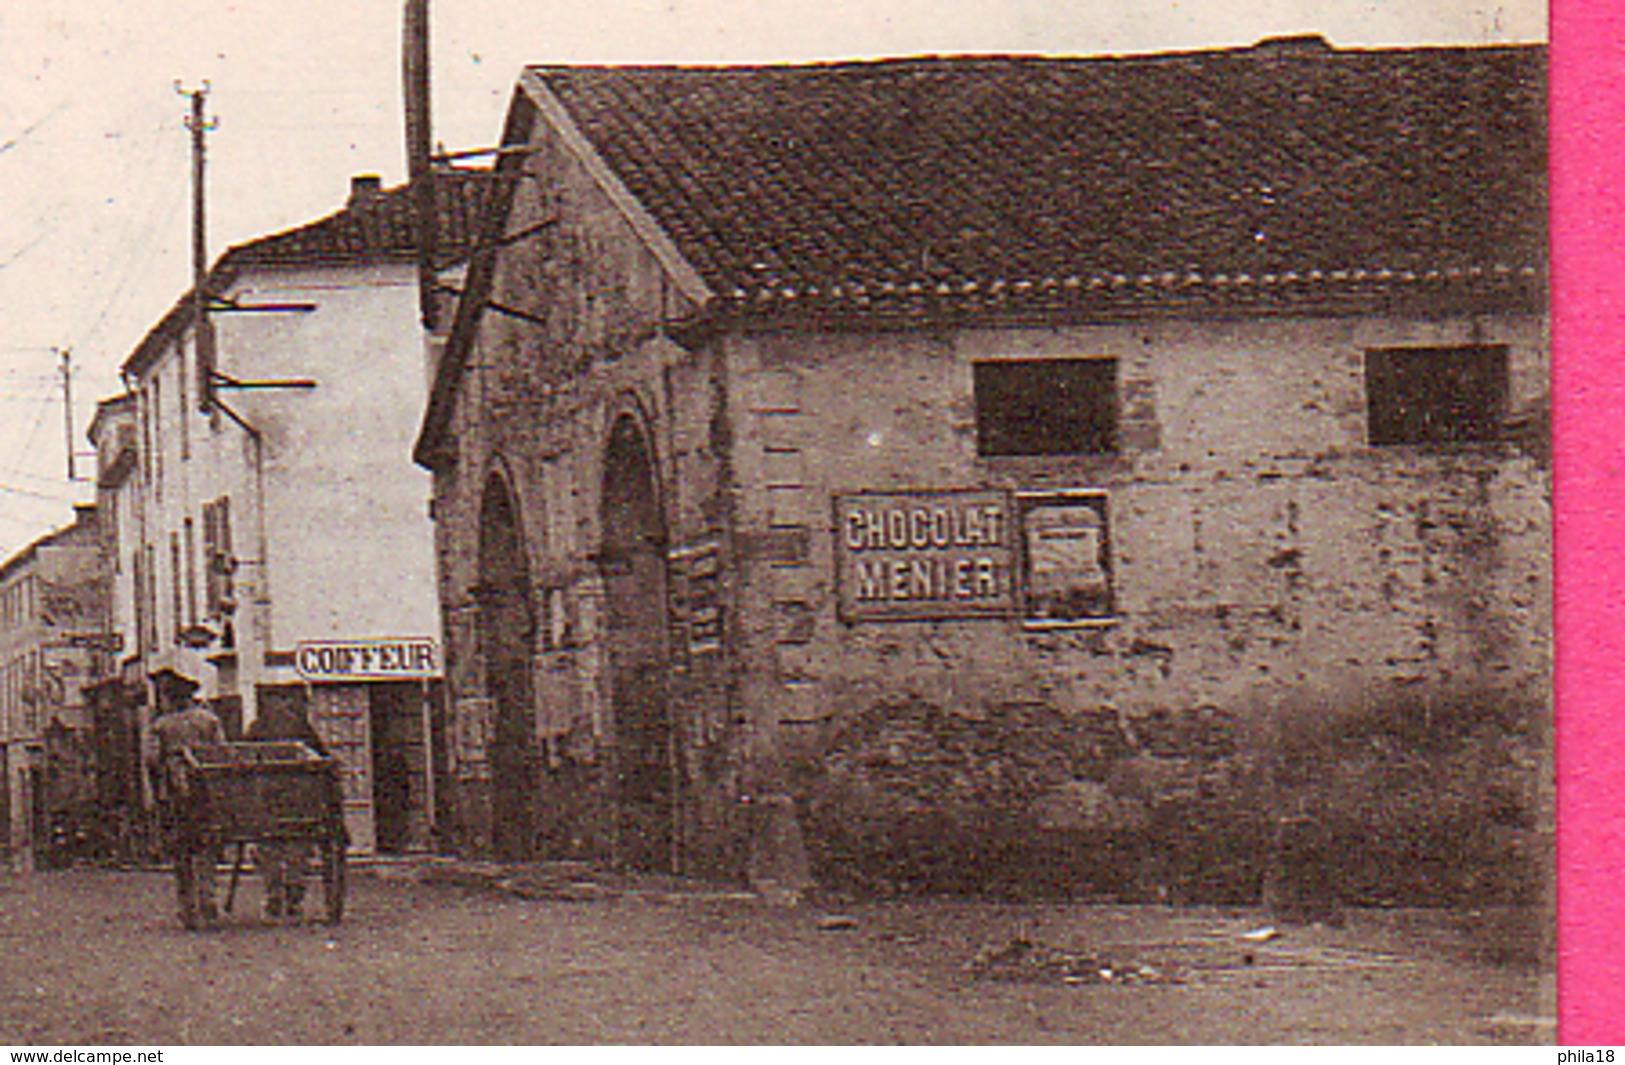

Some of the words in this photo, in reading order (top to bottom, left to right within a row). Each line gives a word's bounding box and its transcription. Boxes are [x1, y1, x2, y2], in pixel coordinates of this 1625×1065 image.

[846, 506, 1002, 550] CHOCOLAT
[857, 557, 999, 600] MENIER
[301, 644, 437, 673] COIFFEUR
